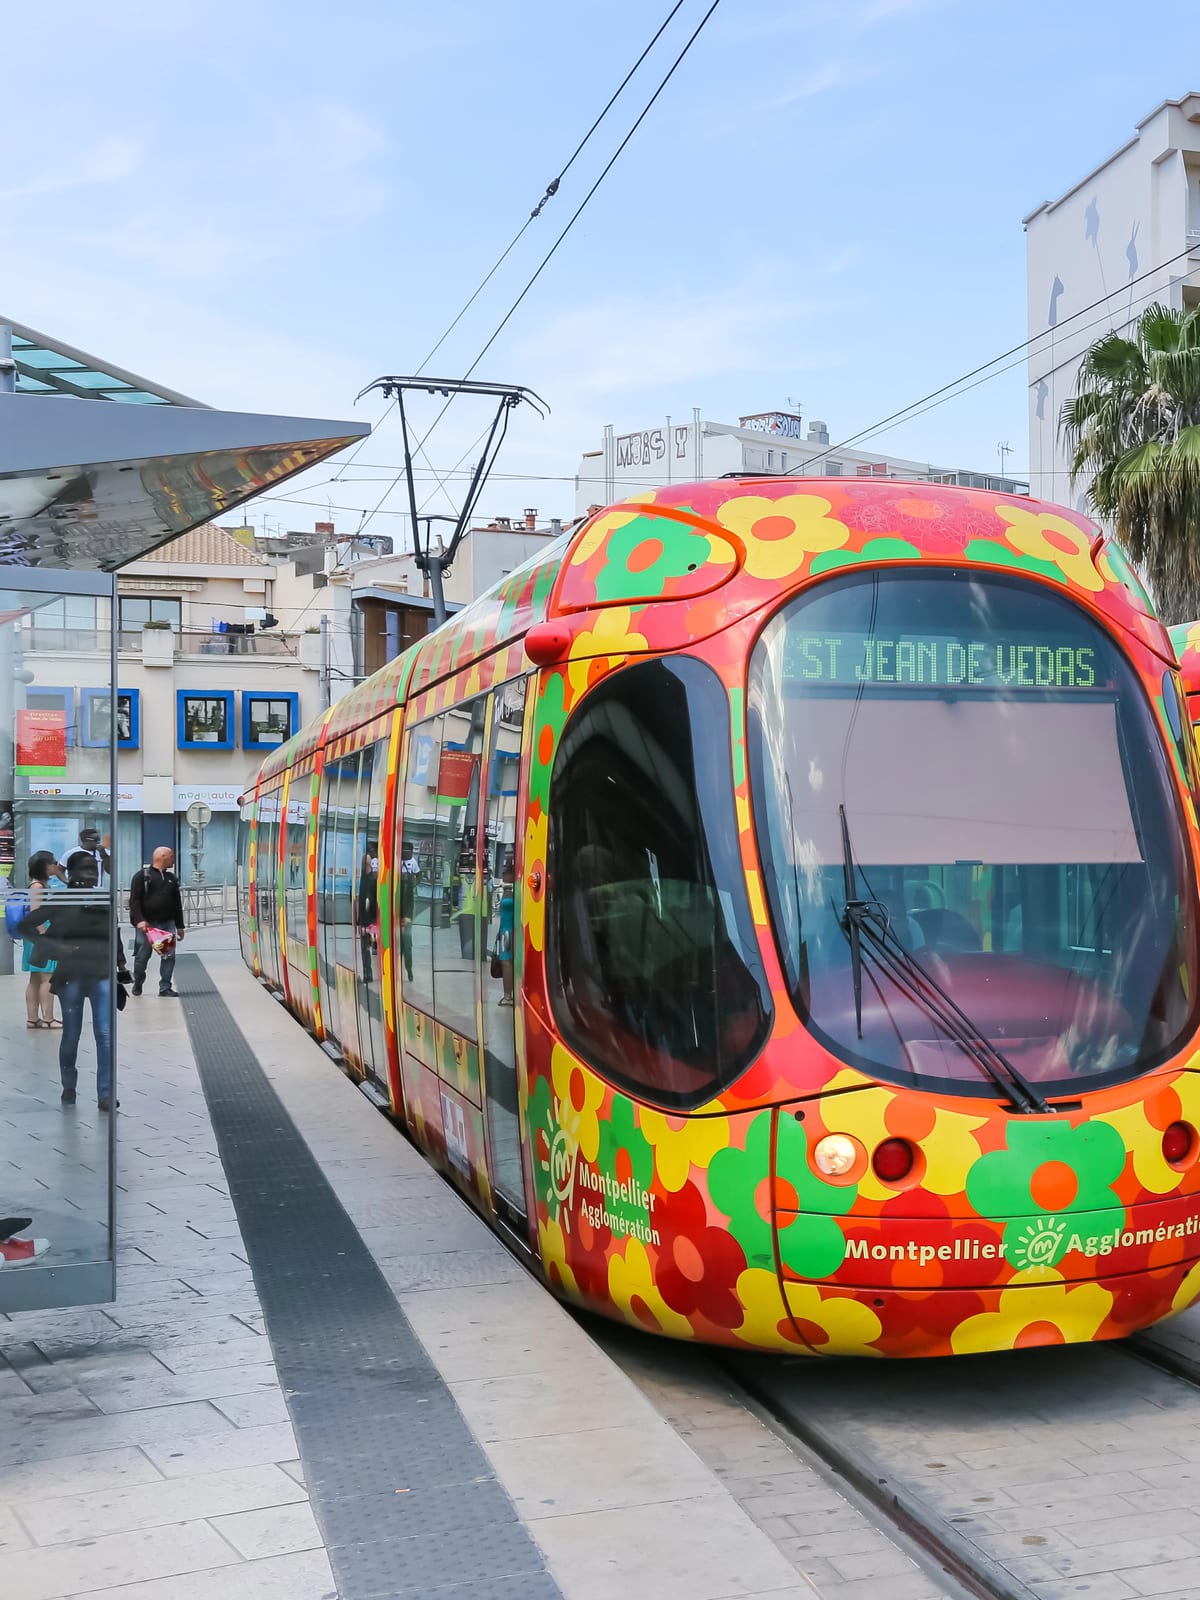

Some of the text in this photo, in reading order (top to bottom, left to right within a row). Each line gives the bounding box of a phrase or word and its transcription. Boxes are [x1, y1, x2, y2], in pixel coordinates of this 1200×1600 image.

[802, 638, 1095, 686] ST JEAN DE VEDAS
[178, 791, 235, 801] modulauto
[579, 1161, 656, 1212] Montpellier
[581, 1198, 661, 1246] Agglomération
[844, 1239, 1008, 1267] Montpellier
